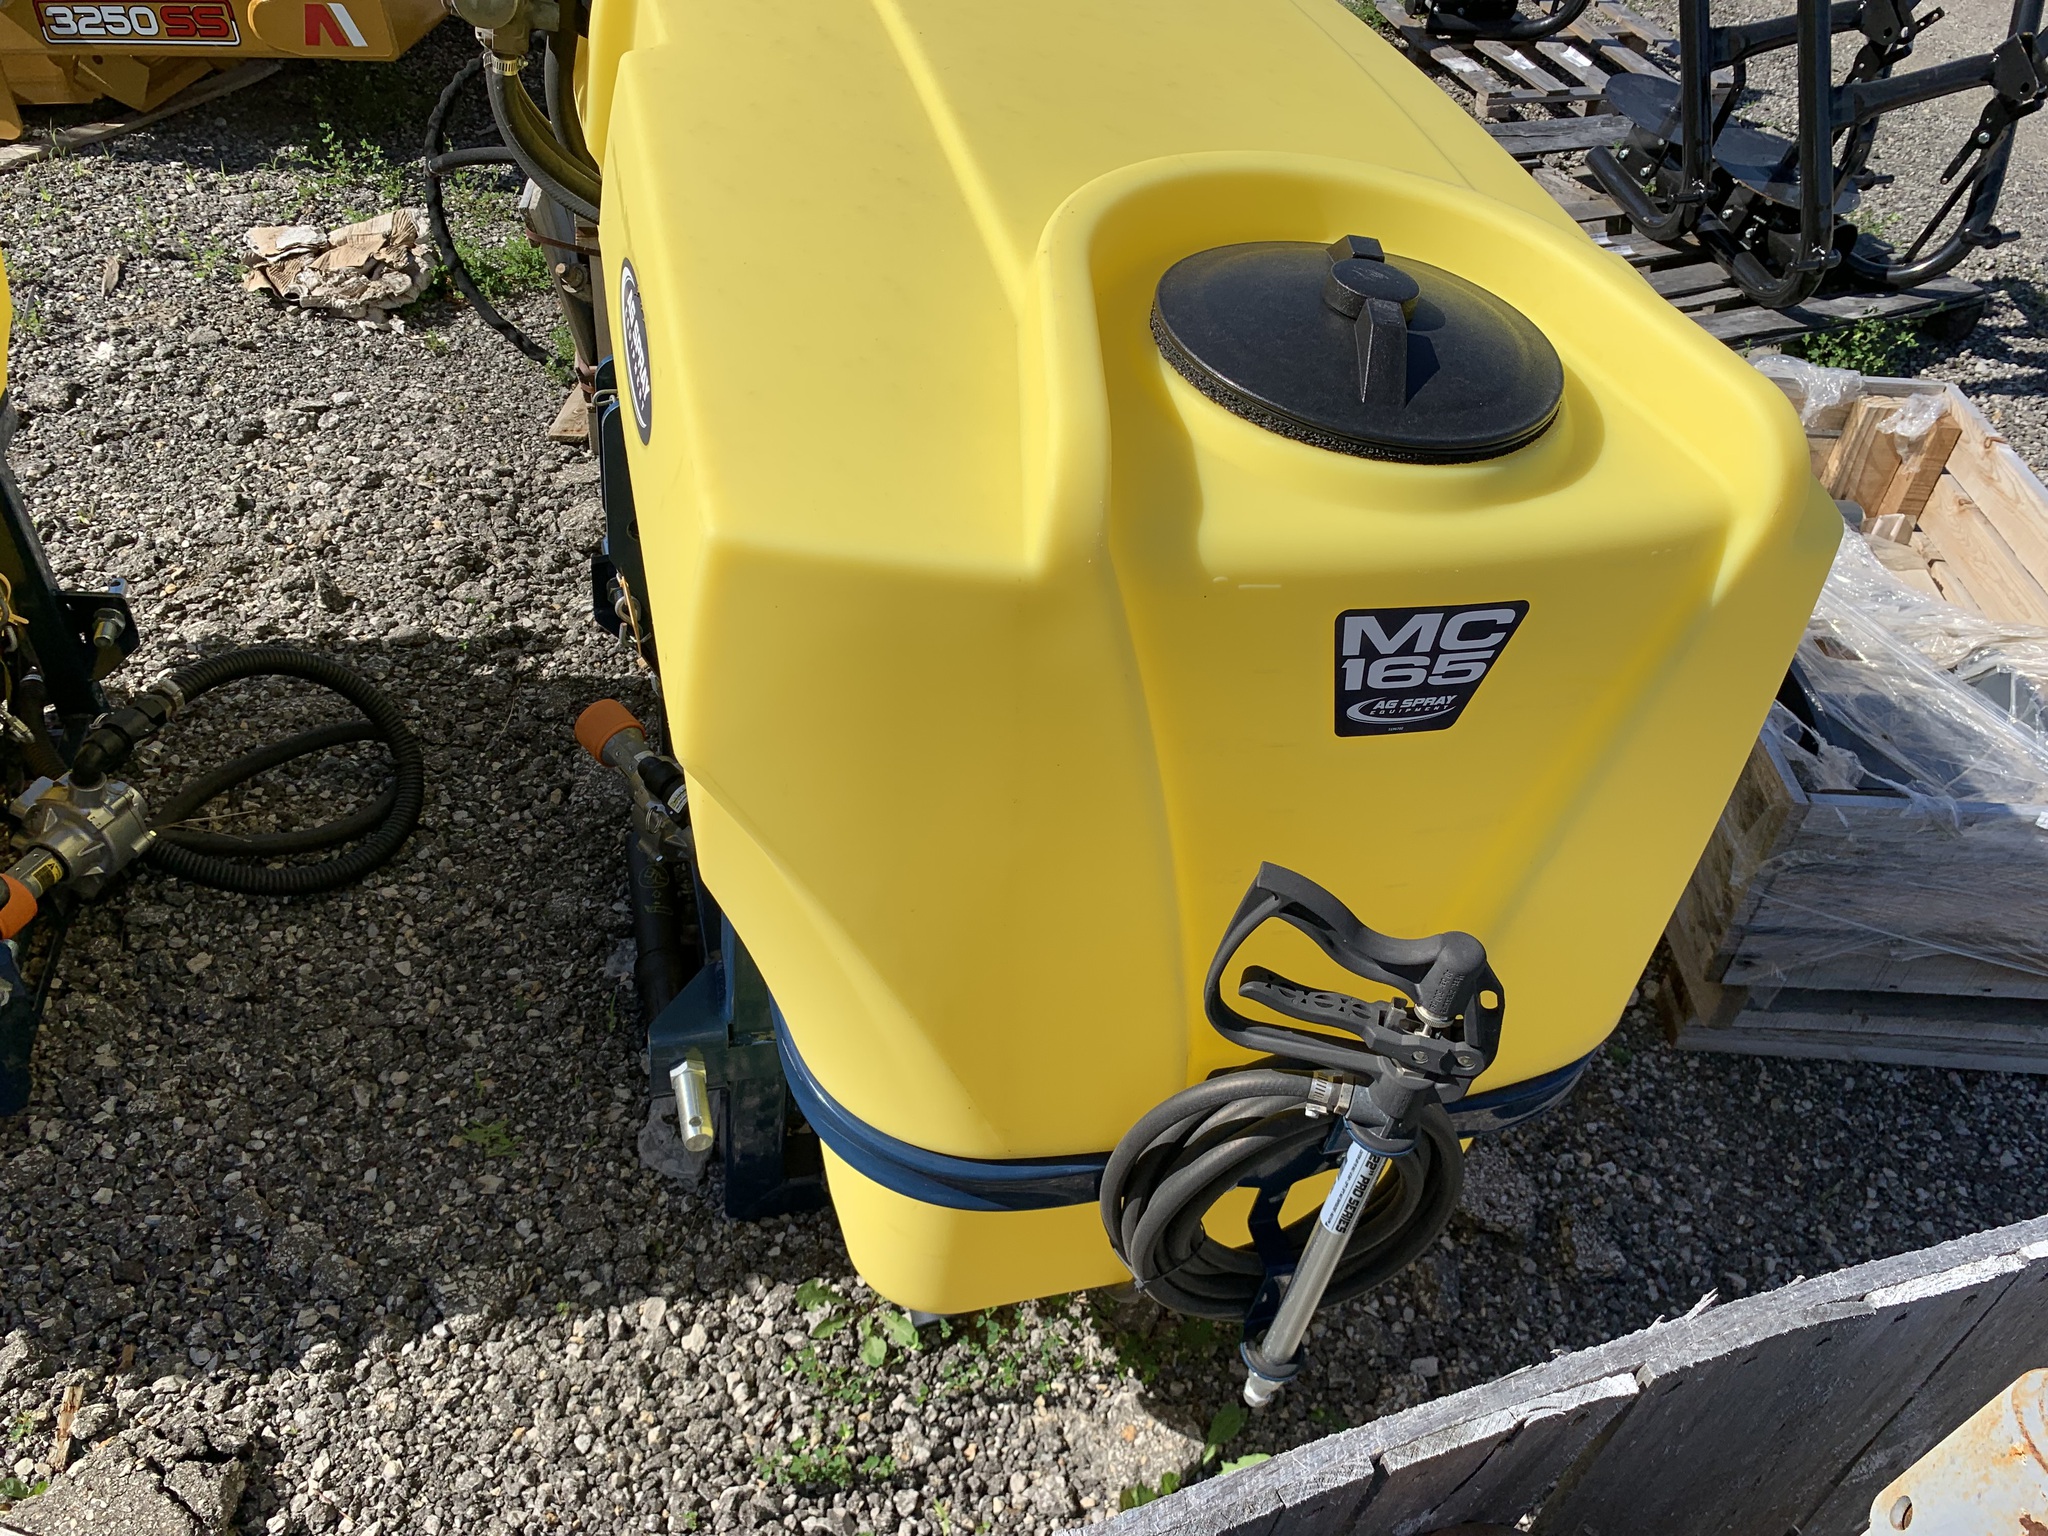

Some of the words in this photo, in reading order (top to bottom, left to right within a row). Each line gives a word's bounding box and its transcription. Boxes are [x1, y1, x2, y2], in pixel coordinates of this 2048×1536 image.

[1342, 608, 1516, 656] MC
[1341, 650, 1495, 691] 165
[1369, 705, 1449, 715] EQUIPMENT
[1373, 699, 1399, 710] AG
[1400, 694, 1458, 709] SPRAY
[1335, 1197, 1360, 1234] SERIES
